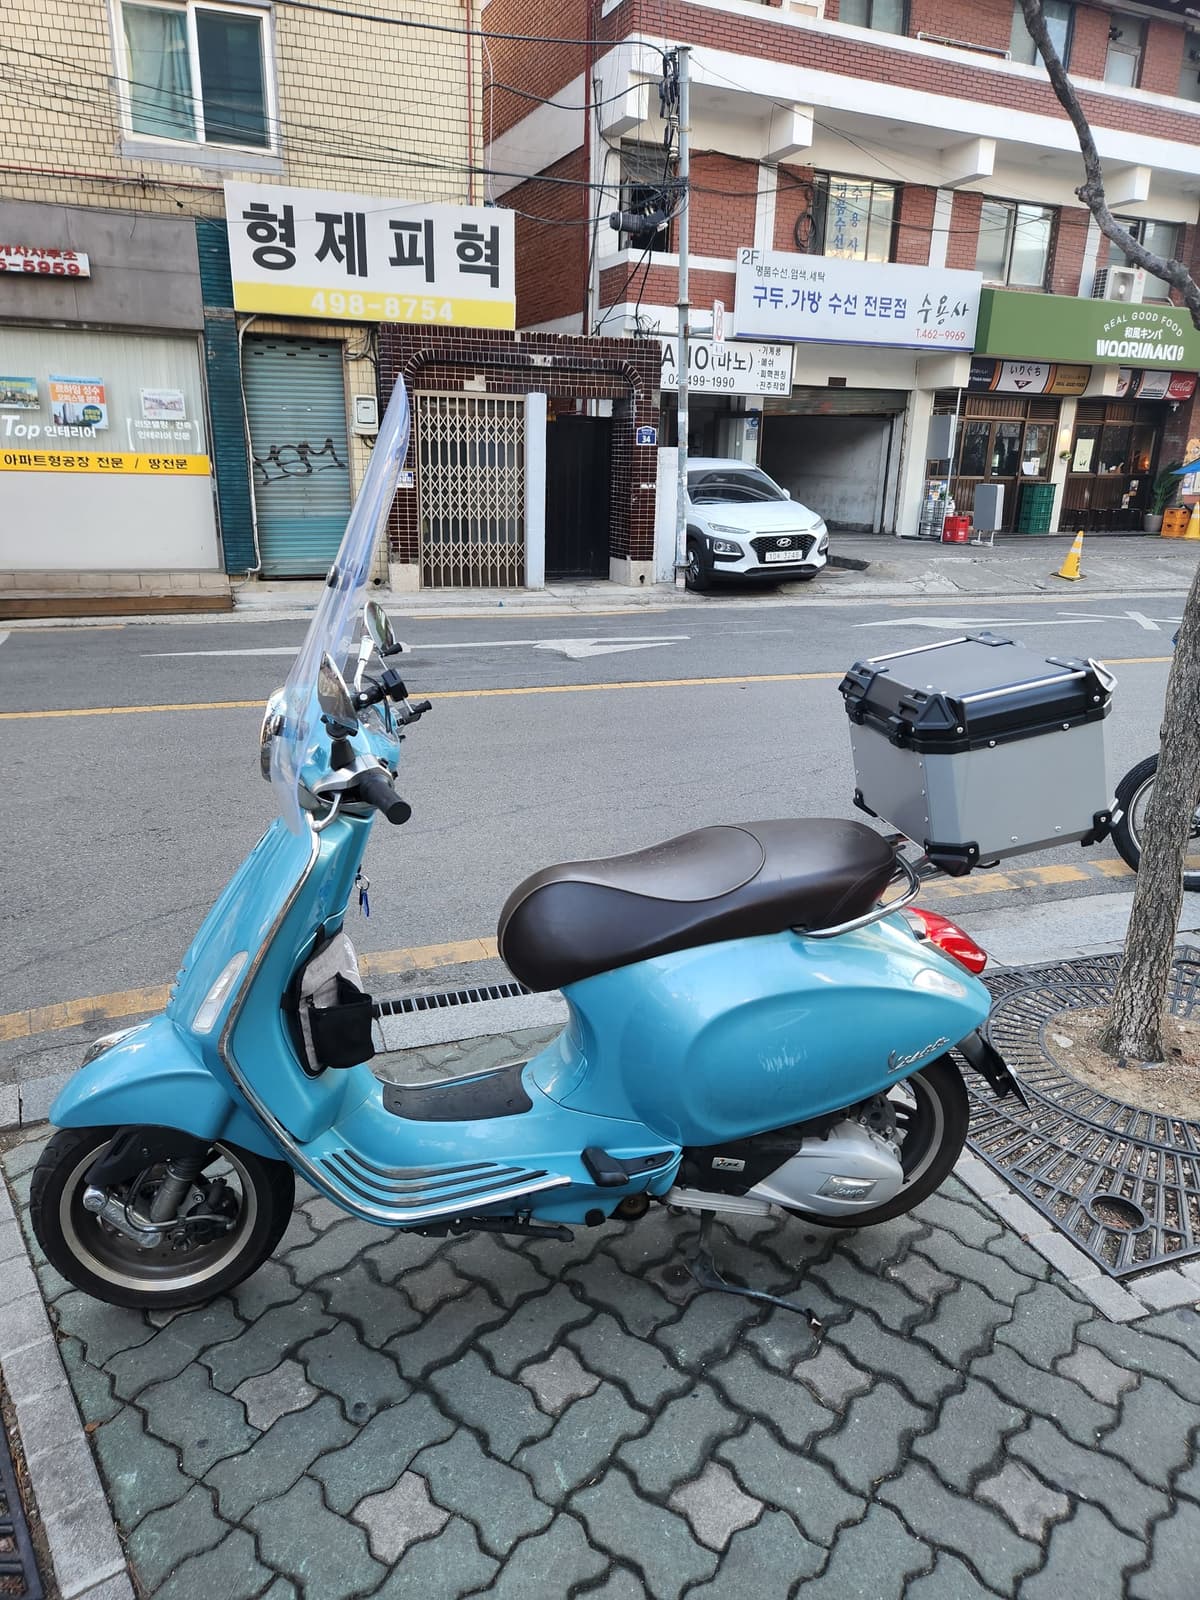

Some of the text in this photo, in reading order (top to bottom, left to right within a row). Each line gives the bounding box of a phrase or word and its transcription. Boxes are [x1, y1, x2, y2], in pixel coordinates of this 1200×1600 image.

[242, 202, 500, 288] 형제피혁
[742, 249, 760, 264] 2F
[311, 291, 453, 320] 498-8754
[752, 285, 907, 319] 구두.가방 수선 전문점
[916, 293, 970, 325] 수용사
[916, 328, 966, 341] T.462-9969
[1103, 311, 1183, 337] REAL GOOD FOOD
[1010, 365, 1041, 377] いりぐち
[2, 414, 97, 440] Top 인테리어
[642, 435, 652, 444] 34
[4, 454, 90, 468] 아파트형공장
[97, 457, 124, 469] 전문
[148, 458, 188, 470] 땅전문
